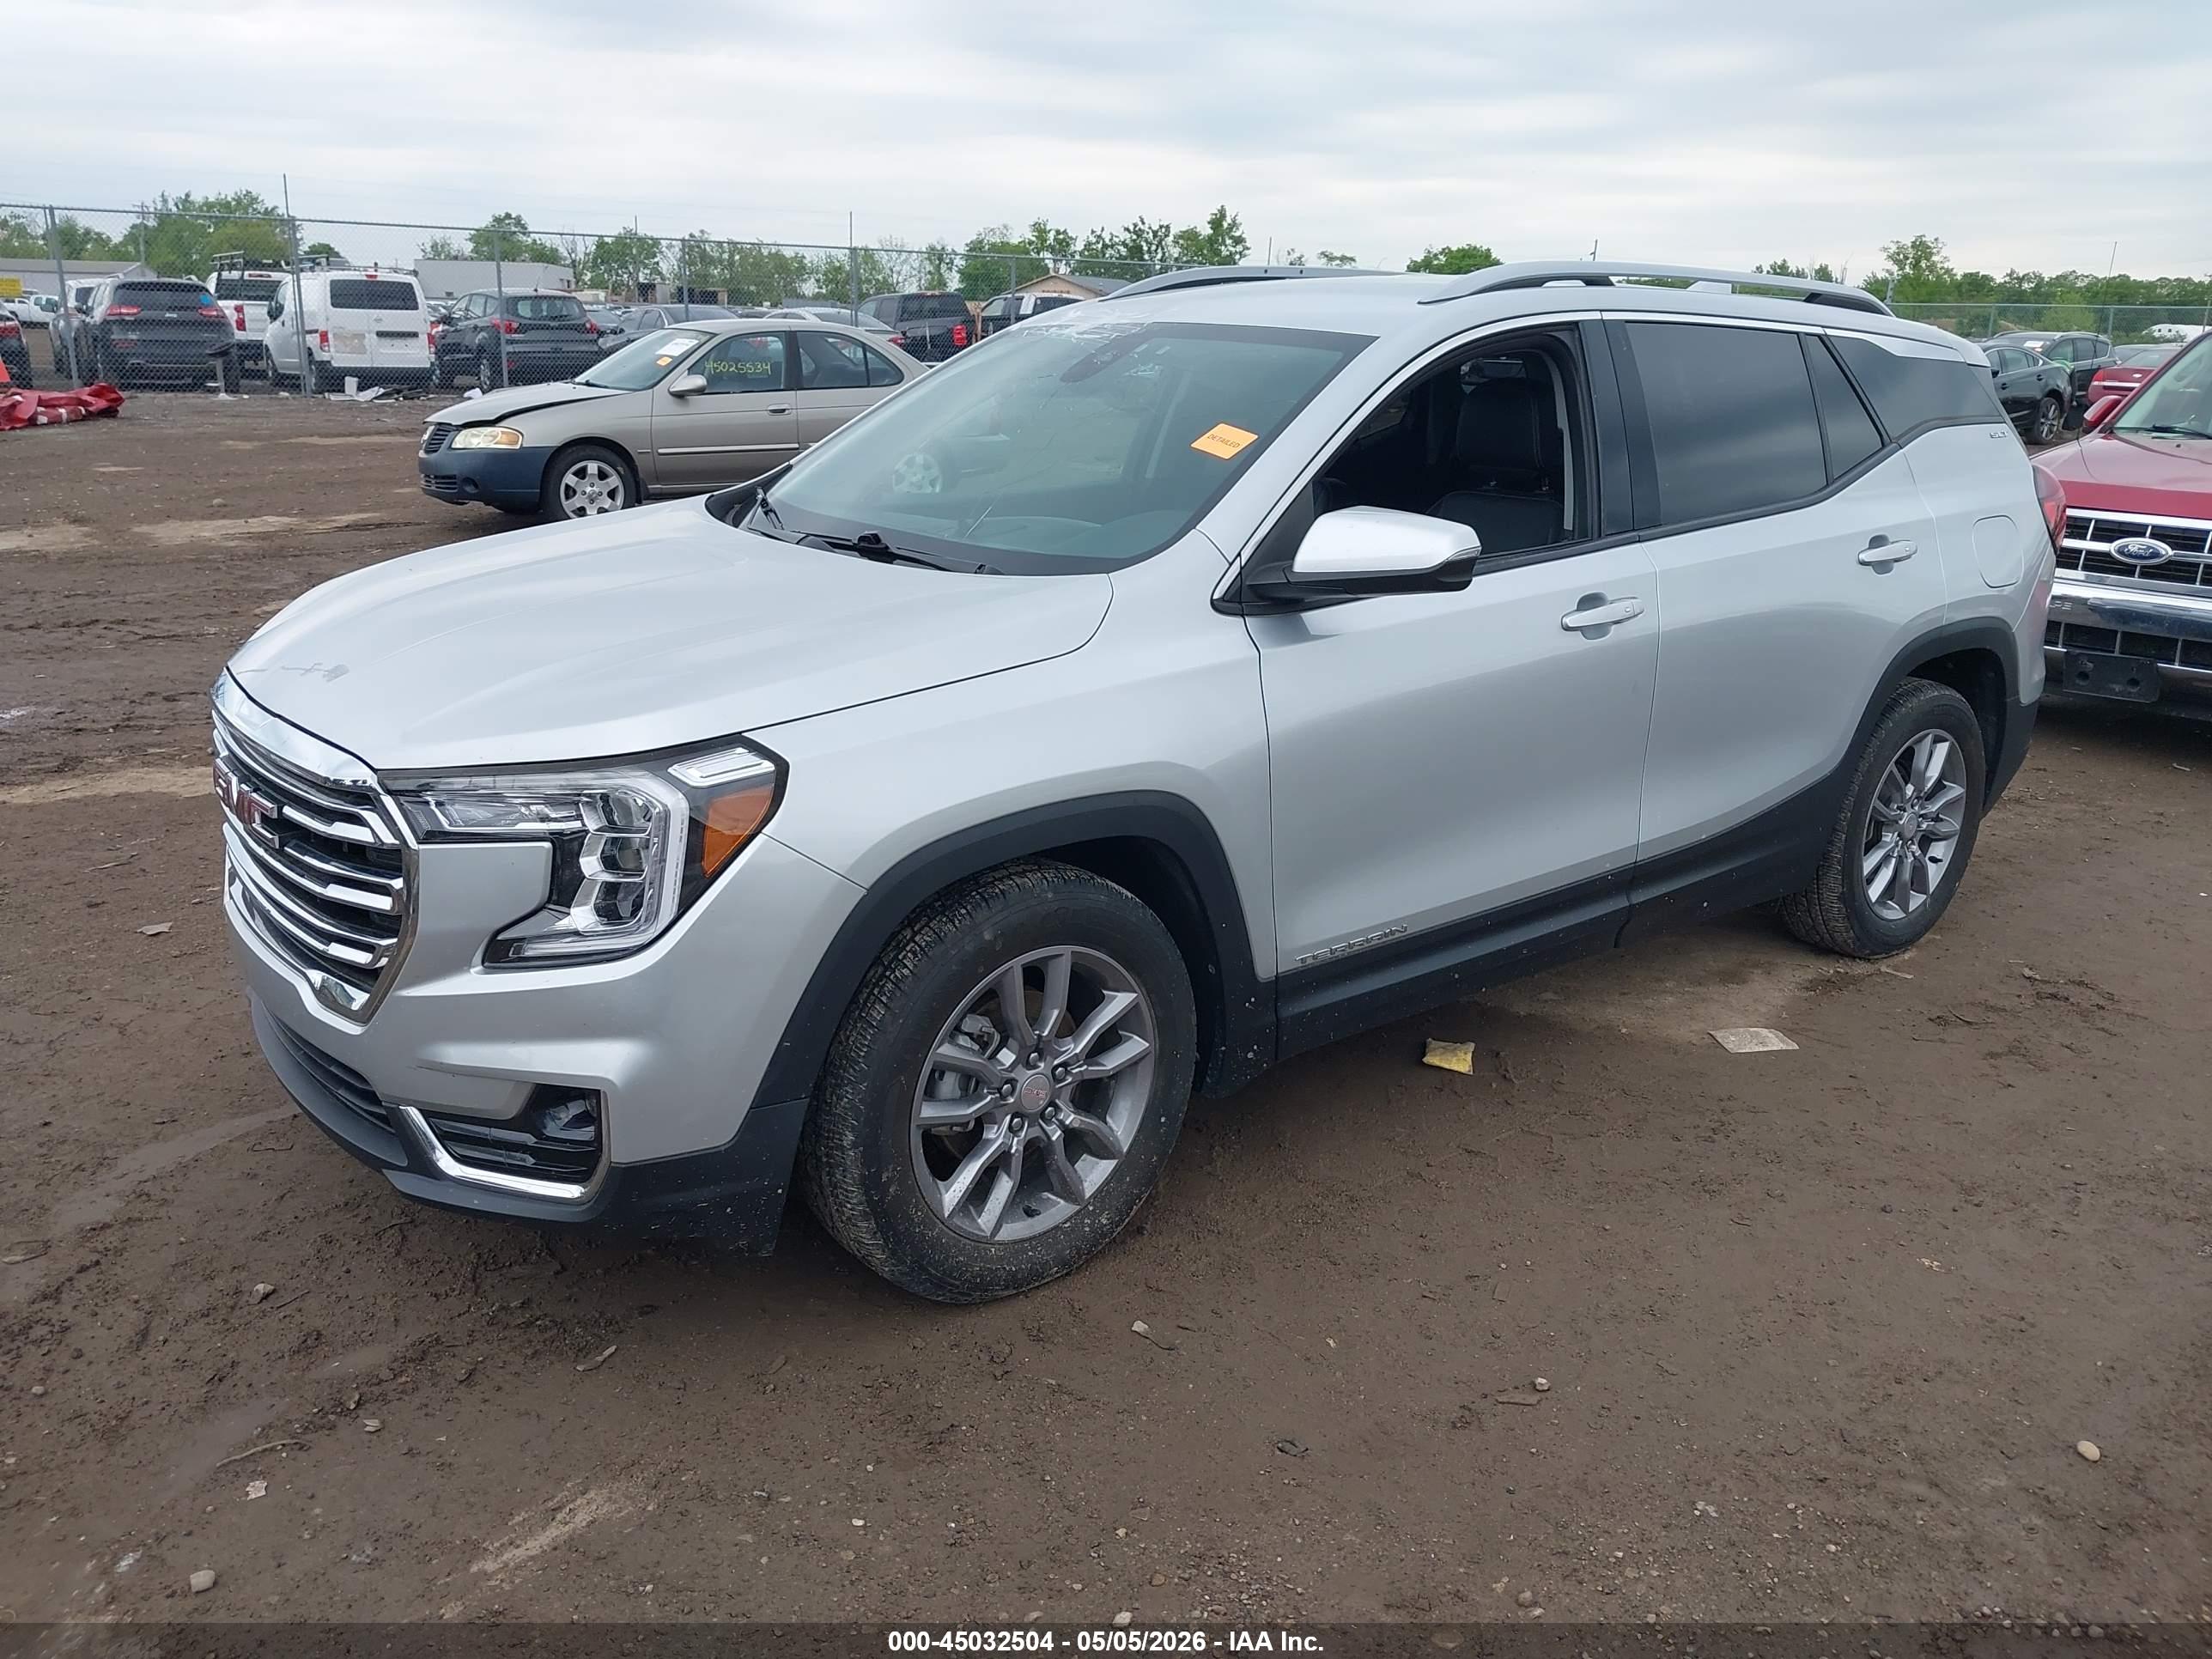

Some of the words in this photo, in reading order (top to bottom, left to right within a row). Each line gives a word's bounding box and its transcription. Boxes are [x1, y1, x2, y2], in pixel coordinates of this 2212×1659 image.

[705, 361, 771, 375] 45025534
[2124, 544, 2154, 557] Ford
[1295, 924, 1407, 963] TERRAIN
